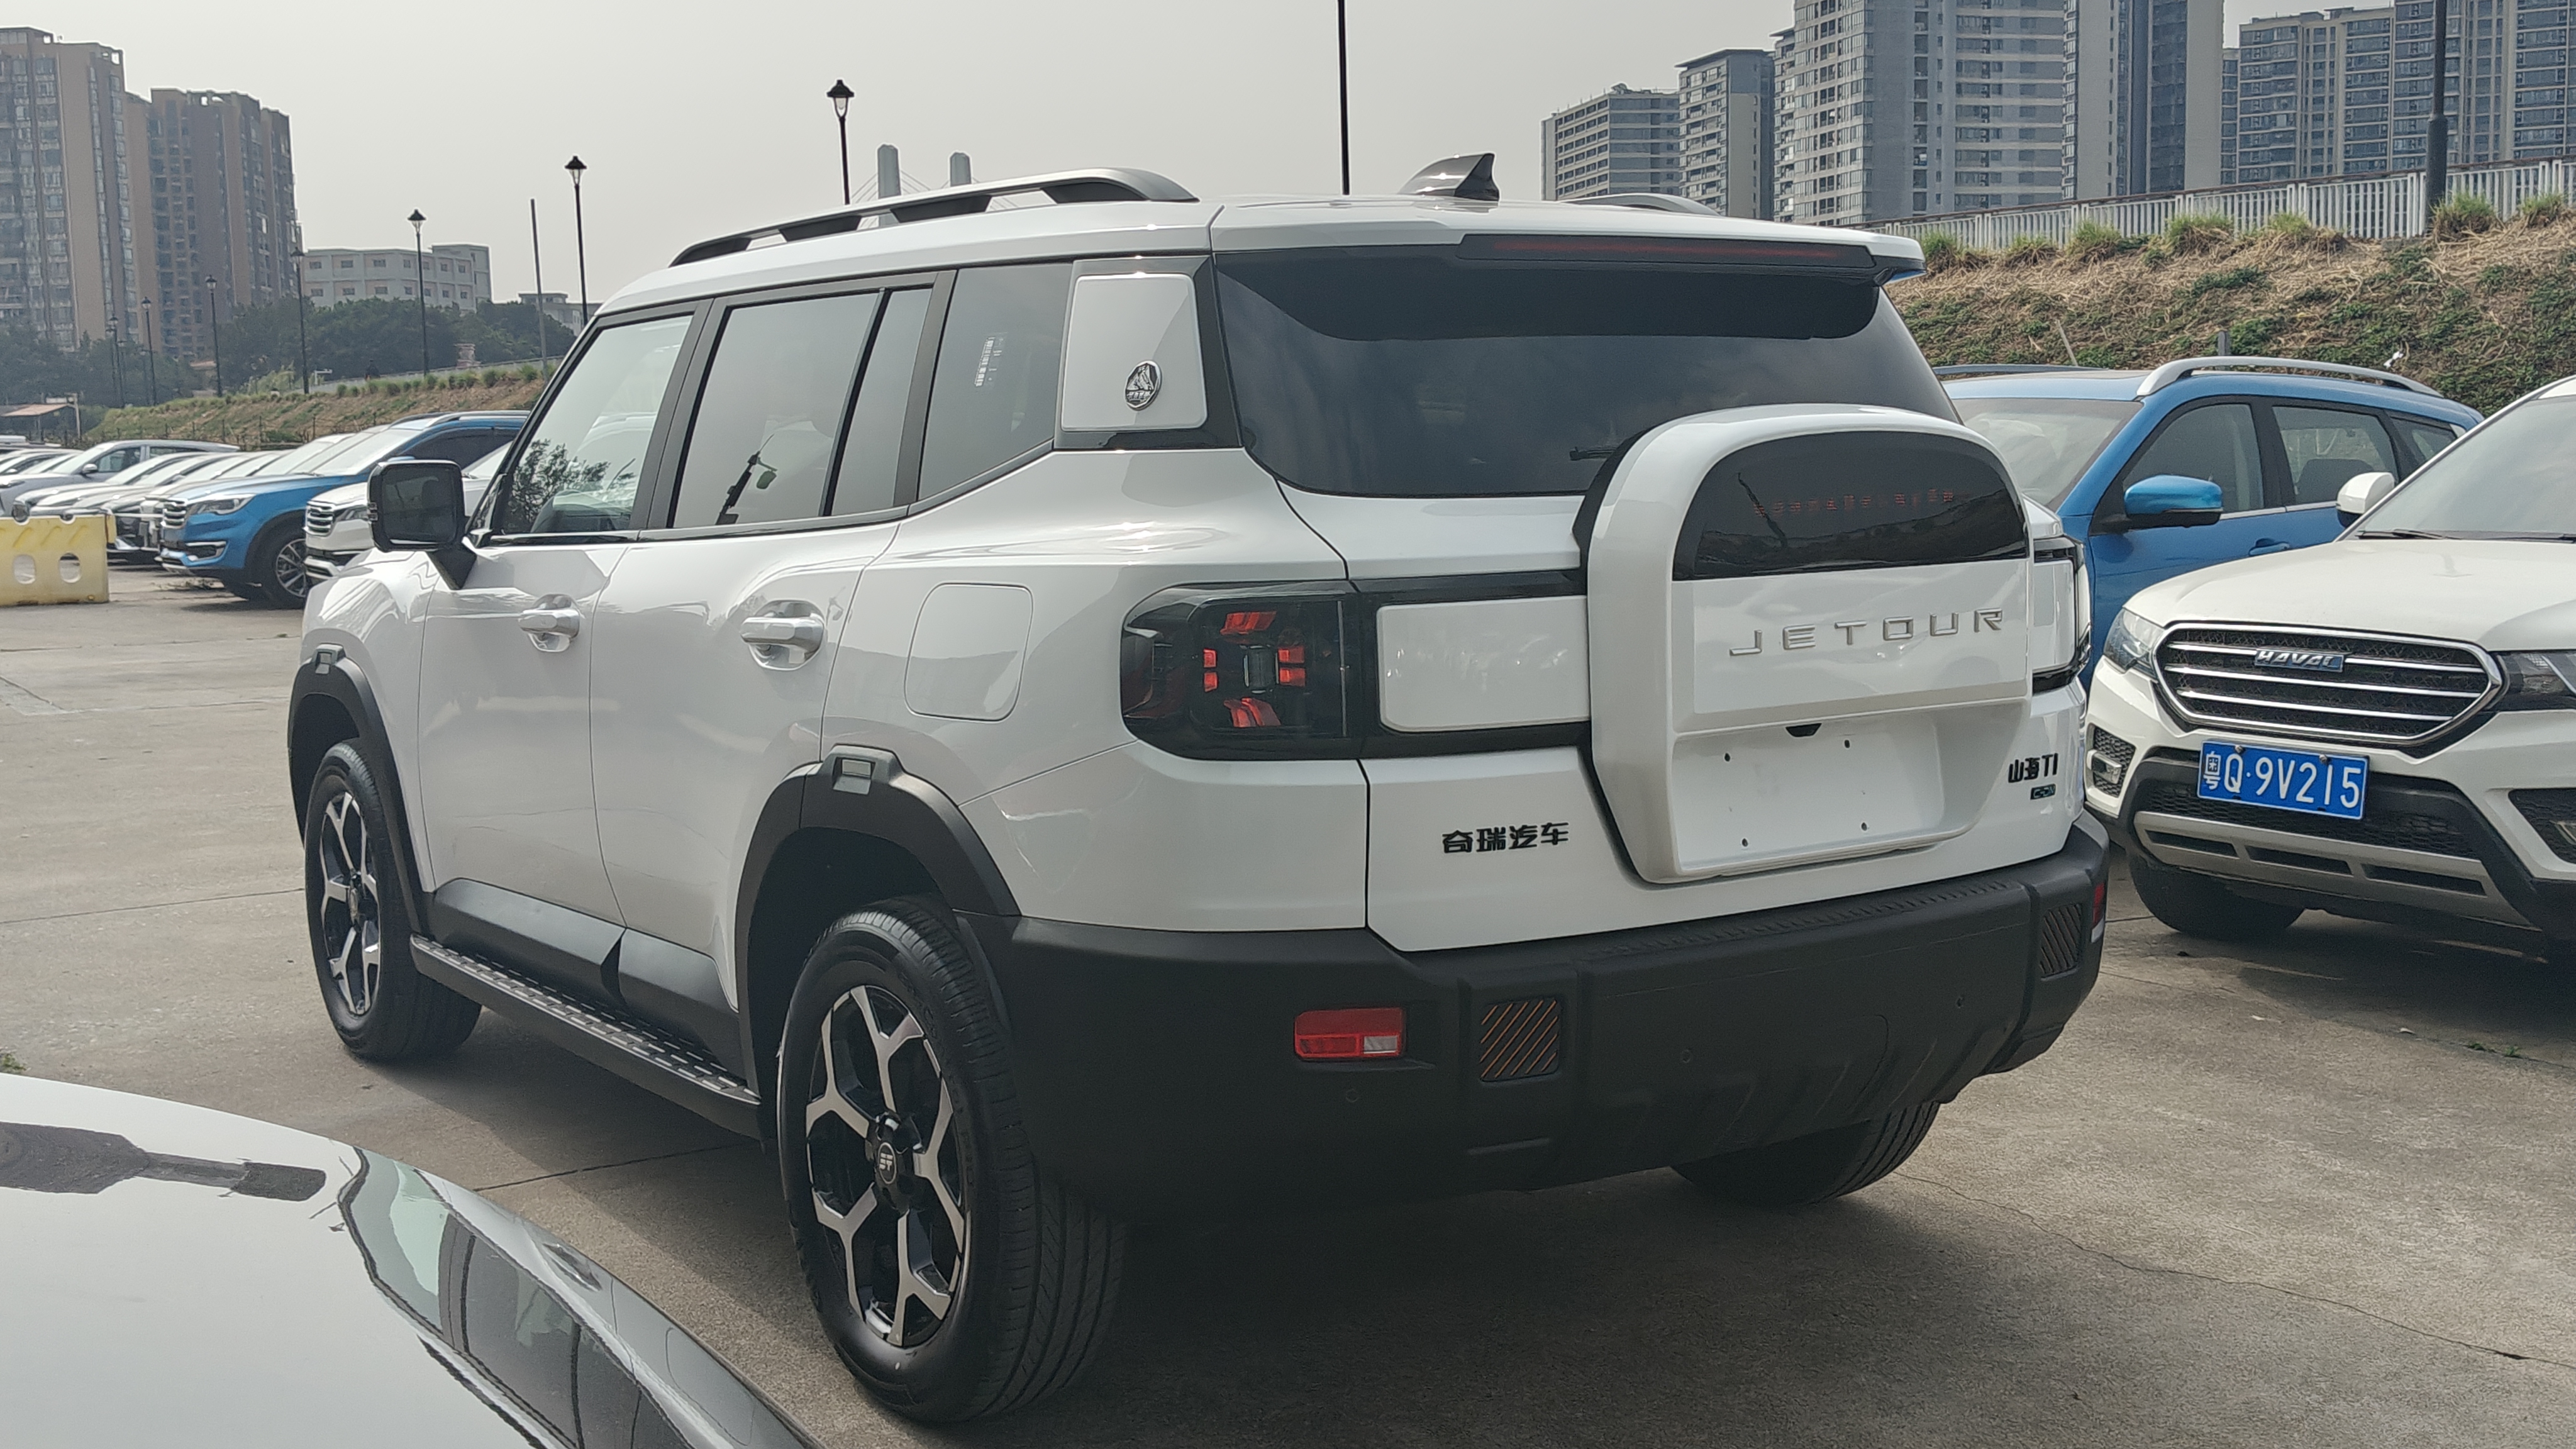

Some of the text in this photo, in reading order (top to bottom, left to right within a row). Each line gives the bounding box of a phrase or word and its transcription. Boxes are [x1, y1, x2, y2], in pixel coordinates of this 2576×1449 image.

[1729, 608, 2002, 656] JETOUR
[2257, 650, 2339, 669] HAVAL
[1442, 823, 1568, 853] 奇瑞汽车
